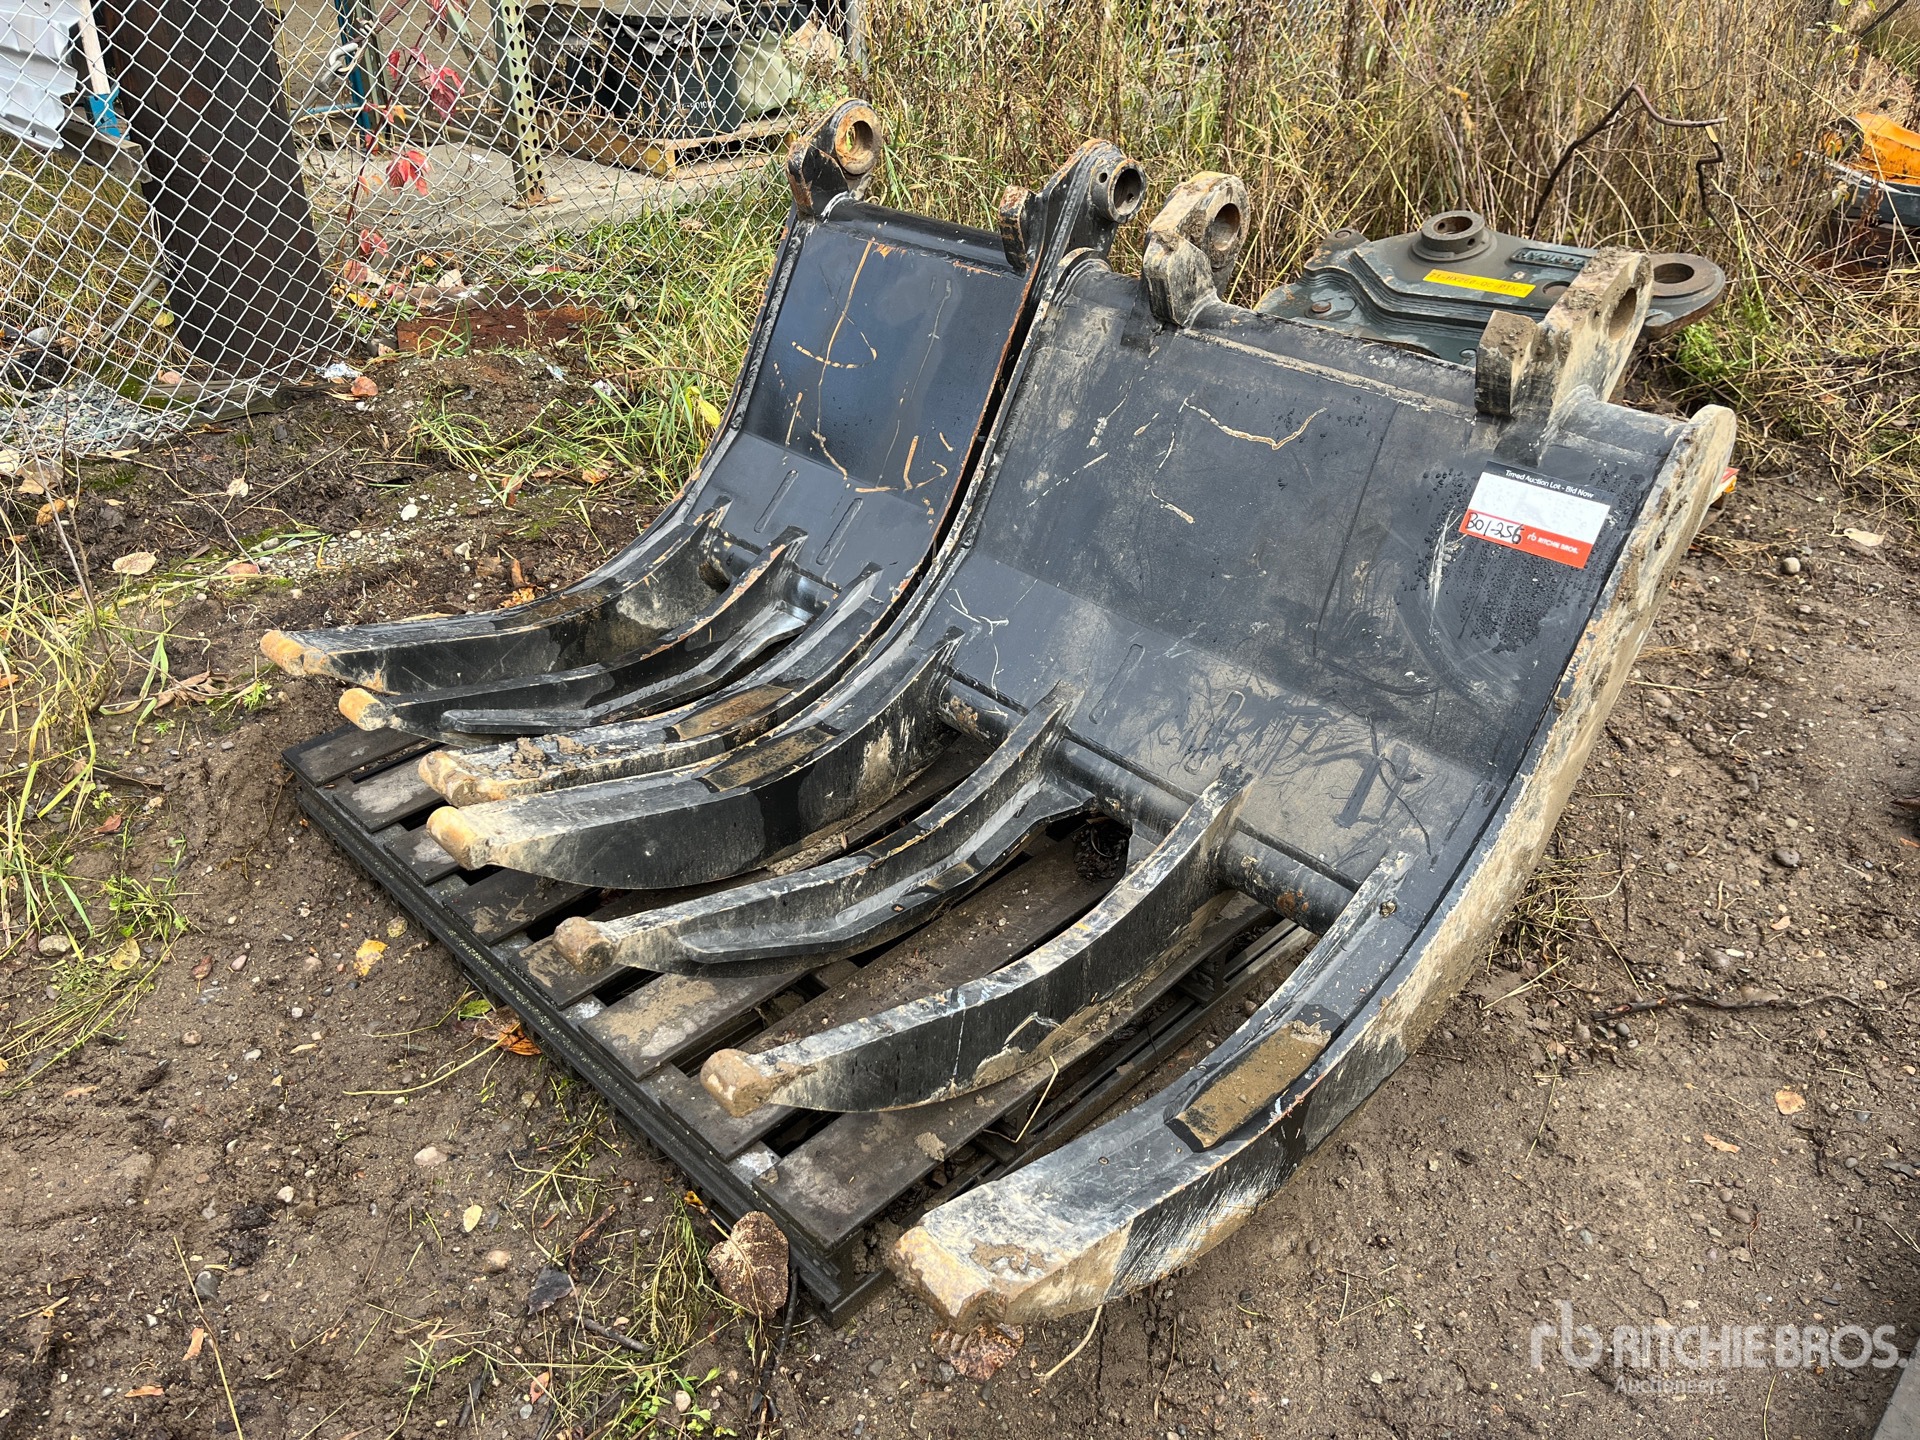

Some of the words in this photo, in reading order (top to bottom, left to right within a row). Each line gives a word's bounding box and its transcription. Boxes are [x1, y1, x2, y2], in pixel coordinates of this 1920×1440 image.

[1505, 469, 1525, 480] Timed
[1525, 475, 1550, 487] Auction
[1549, 482, 1561, 490] Lot
[1565, 486, 1577, 495] Bid
[1577, 489, 1595, 499] Now
[1537, 537, 1561, 550] RITCHIE
